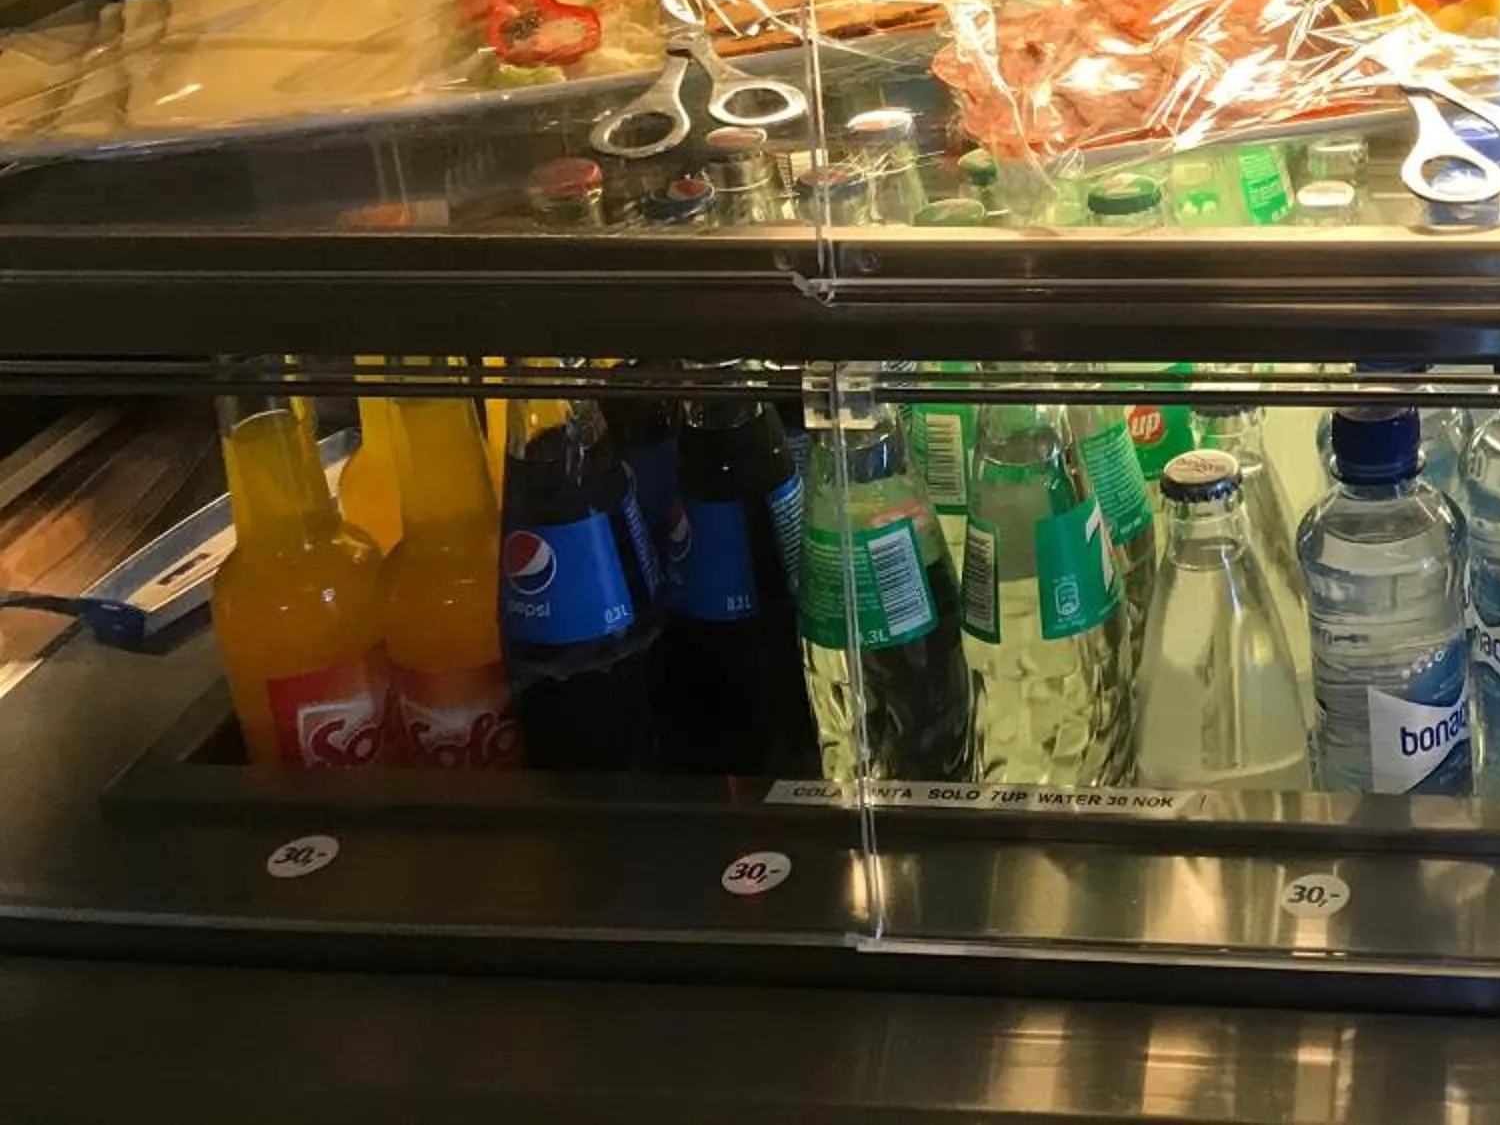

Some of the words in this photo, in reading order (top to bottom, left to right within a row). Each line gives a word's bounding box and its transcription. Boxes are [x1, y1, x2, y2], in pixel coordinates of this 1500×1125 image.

[1131, 410, 1161, 441] up
[1400, 710, 1466, 757] bona
[793, 786, 842, 798] COLA
[928, 787, 980, 800] SOLO
[991, 790, 1028, 803] 7UP
[1038, 792, 1102, 806] WATER
[1107, 796, 1129, 808] 30
[1133, 796, 1175, 808] NOK
[728, 862, 781, 884] 30,-
[1287, 884, 1341, 908] 30,-
